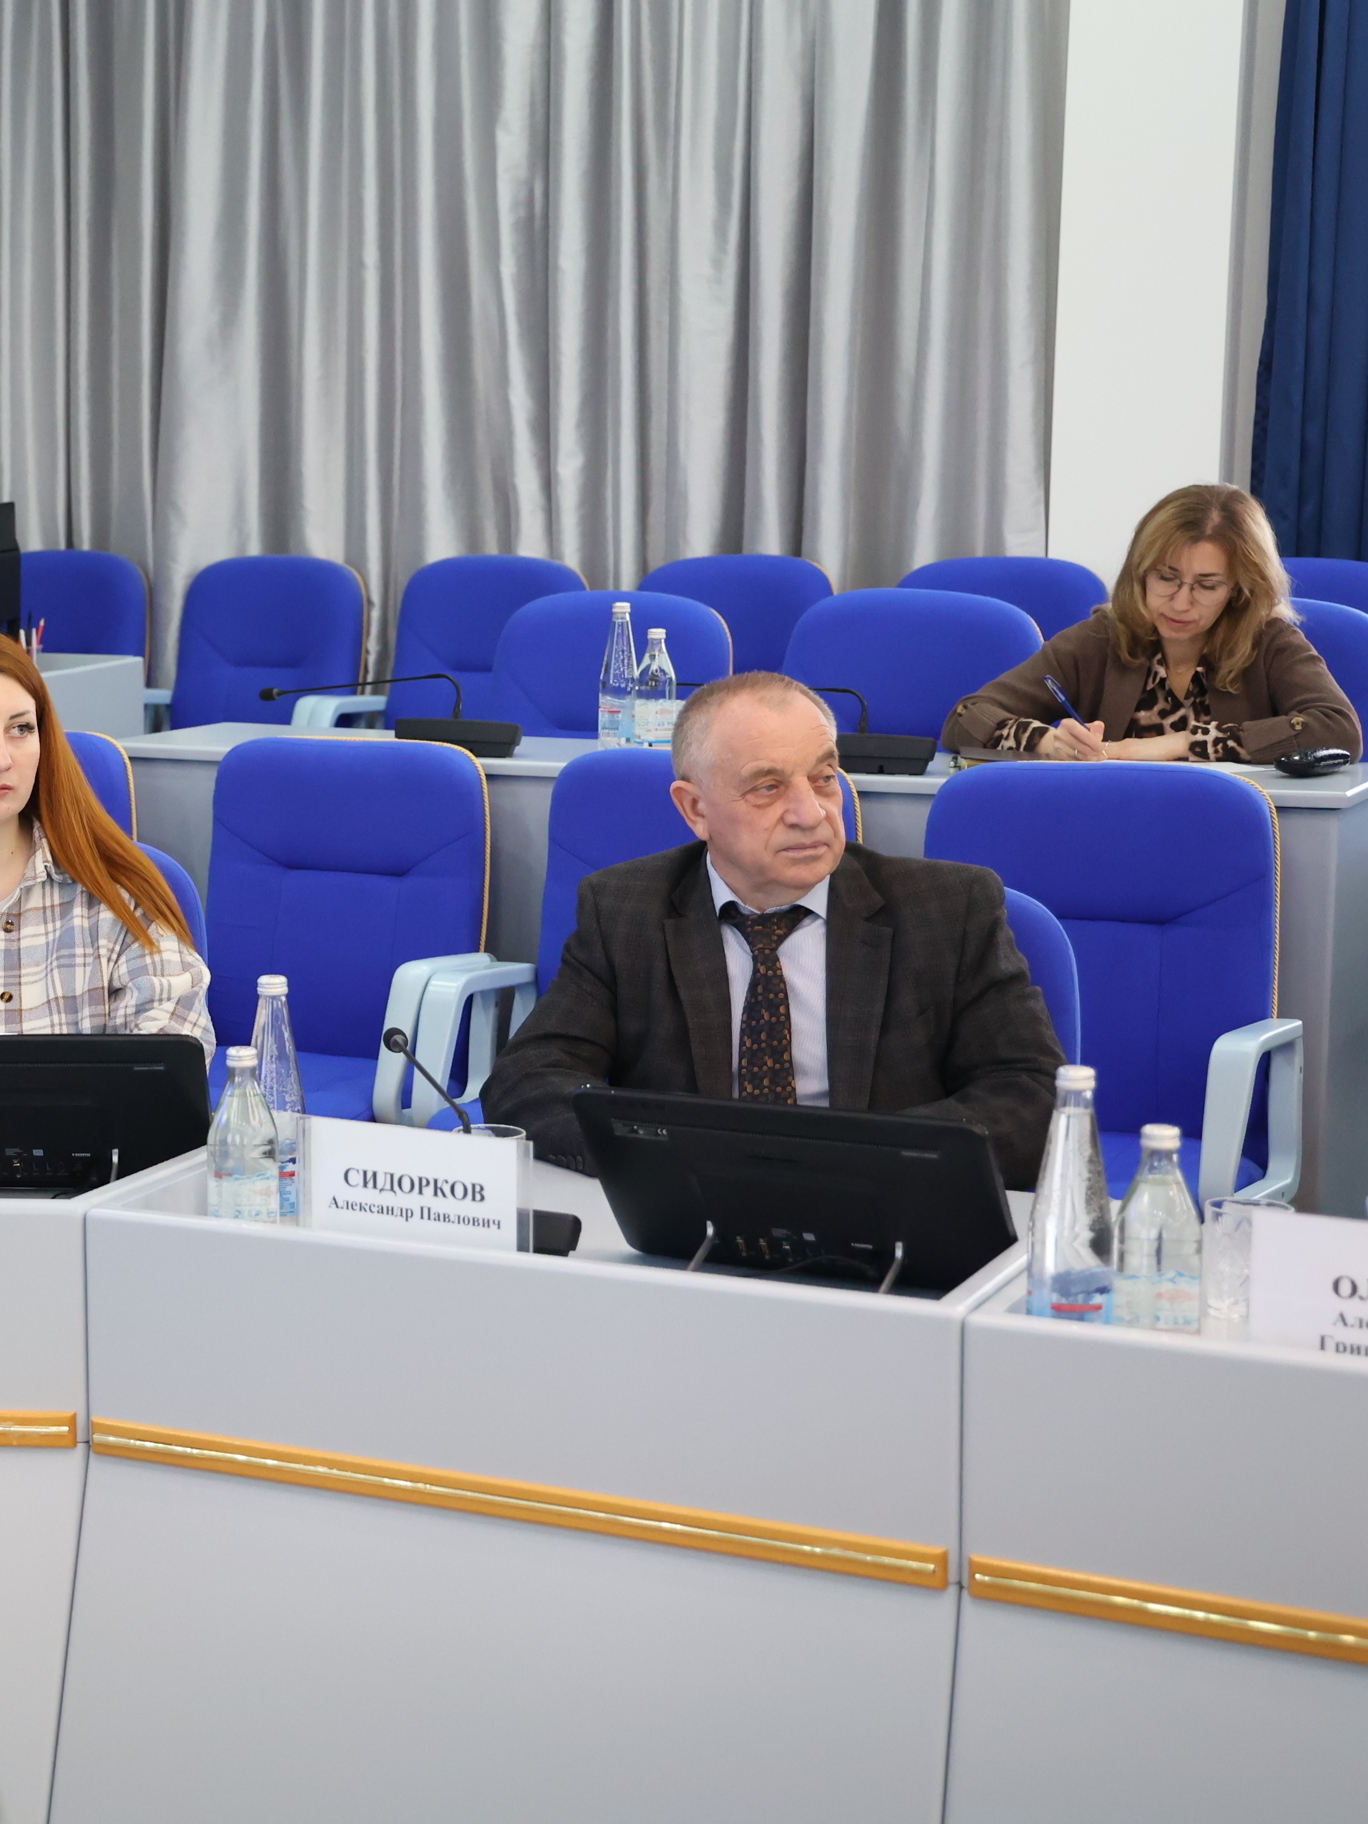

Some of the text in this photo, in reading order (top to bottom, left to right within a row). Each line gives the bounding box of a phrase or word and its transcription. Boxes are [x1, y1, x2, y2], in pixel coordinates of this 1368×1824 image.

[342, 1166, 487, 1203] СИДОРКОВ
[328, 1195, 502, 1231] Александр Павлович
